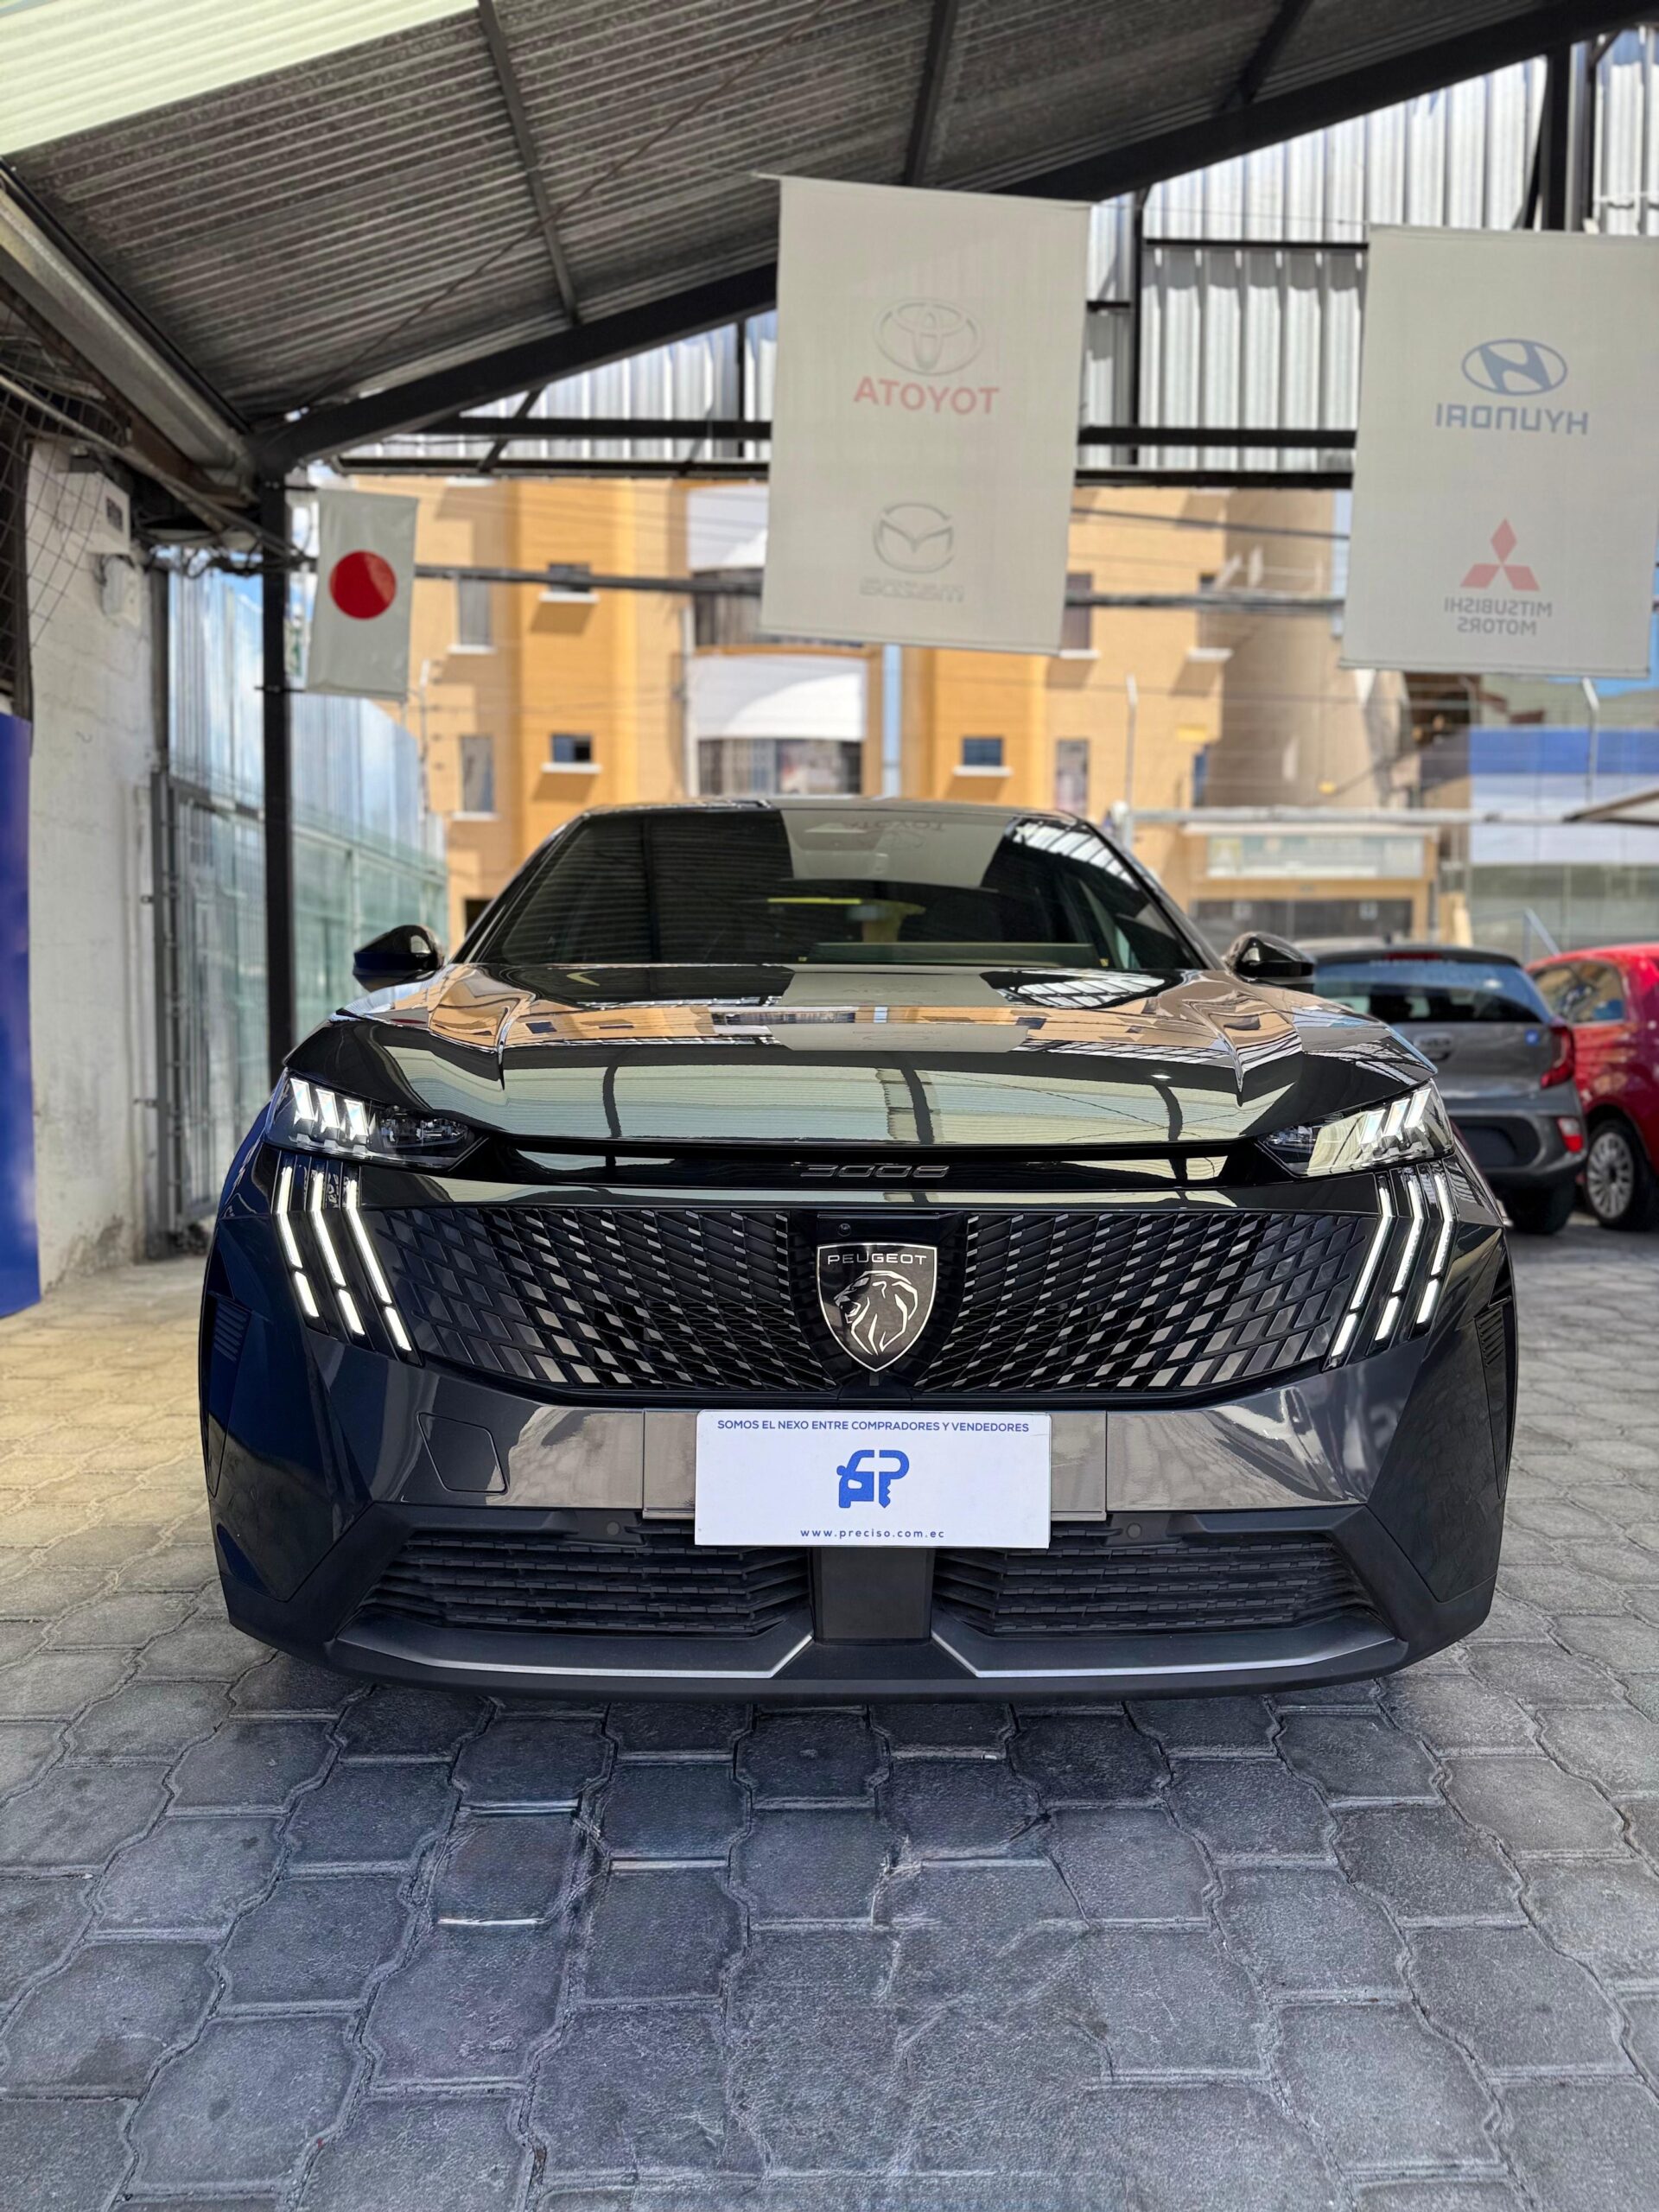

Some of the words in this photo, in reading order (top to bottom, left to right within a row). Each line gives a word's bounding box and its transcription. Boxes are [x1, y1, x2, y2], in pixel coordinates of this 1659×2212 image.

[800, 1164, 950, 1178] 3008
[827, 1253, 927, 1265] PEUGEOT
[717, 1420, 760, 1430] SOMOS
[761, 1420, 776, 1430] EL
[778, 1420, 810, 1430] NEXO
[811, 1421, 849, 1431] ENTRE
[851, 1421, 940, 1432] COMPRADORES
[942, 1421, 950, 1432] Y
[951, 1422, 1030, 1433] VENDEDORES
[800, 1529, 944, 1540] www.preciso.com.ec
